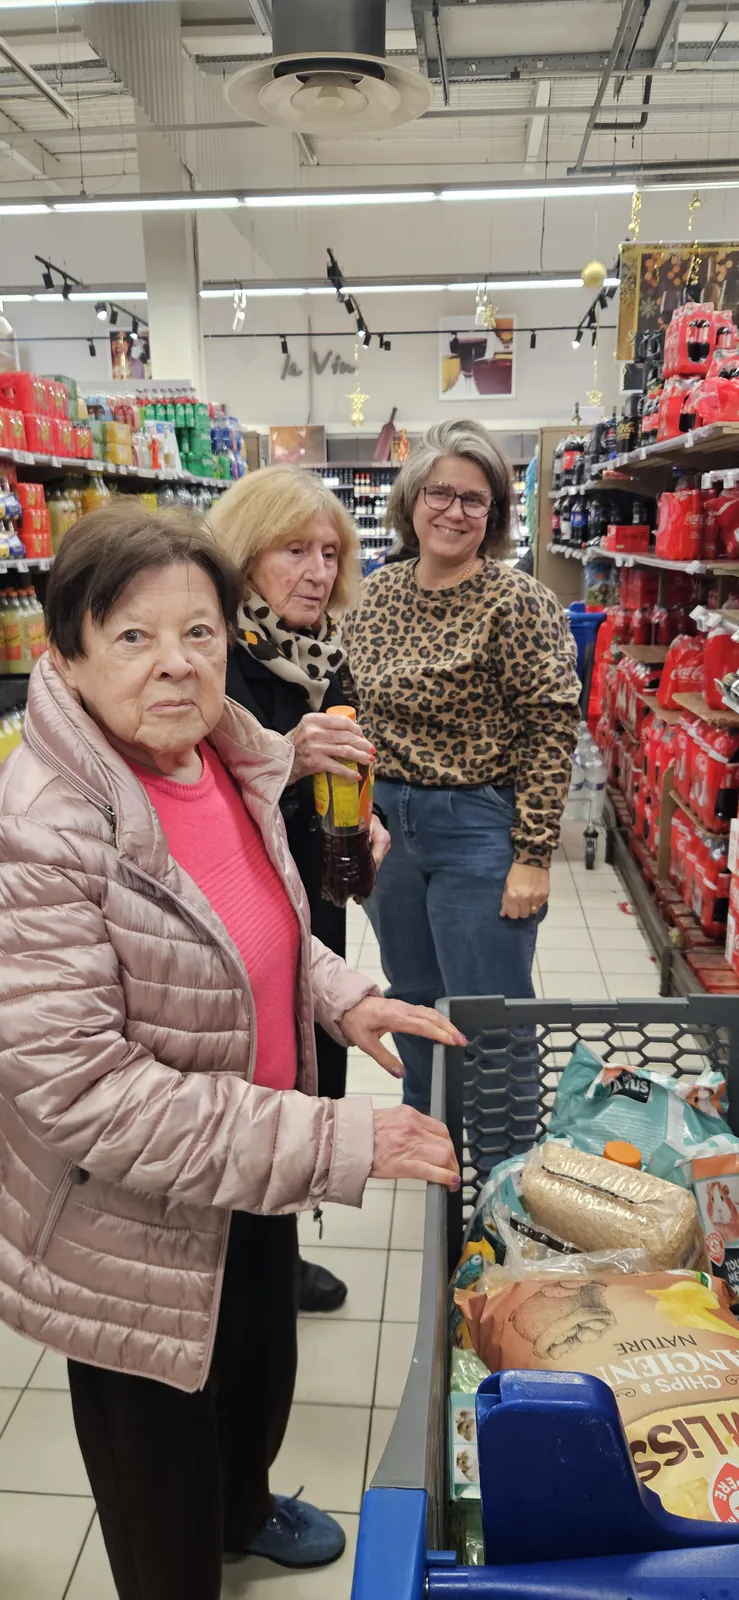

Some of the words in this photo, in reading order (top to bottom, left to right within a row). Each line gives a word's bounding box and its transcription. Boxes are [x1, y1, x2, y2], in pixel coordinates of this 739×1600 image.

[613, 1334, 697, 1356] NATURE
[641, 1383, 652, 1394] à
[655, 1374, 721, 1393] CHIPS
